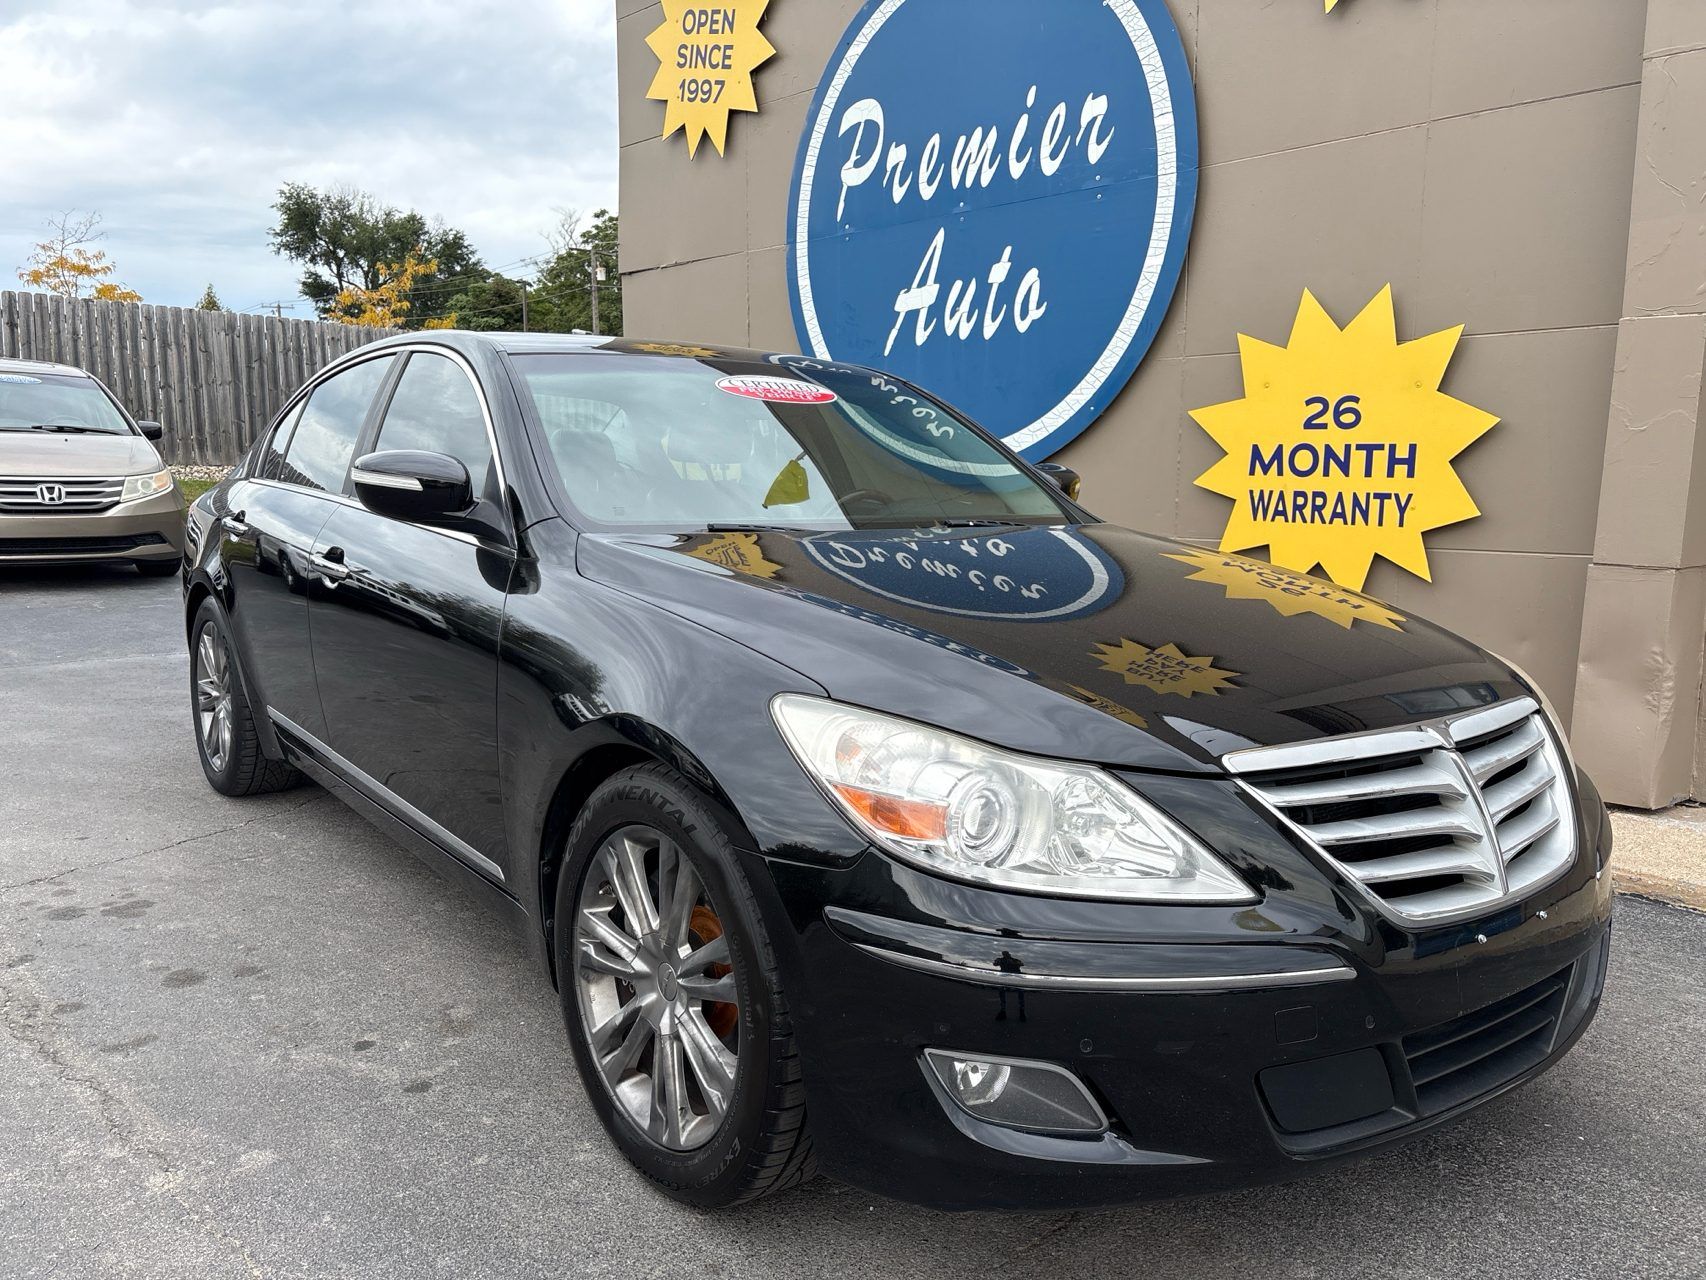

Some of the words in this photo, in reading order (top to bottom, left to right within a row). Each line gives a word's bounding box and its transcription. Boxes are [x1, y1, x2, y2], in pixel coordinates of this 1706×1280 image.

[682, 9, 736, 35] OPEN
[676, 44, 734, 70] SINCE
[678, 78, 726, 104] 1997
[836, 85, 1116, 222] Premier
[882, 227, 1047, 356] Auto
[1302, 394, 1363, 430] 26
[1248, 442, 1418, 479] MONTH
[1248, 488, 1414, 528] WARRANTY
